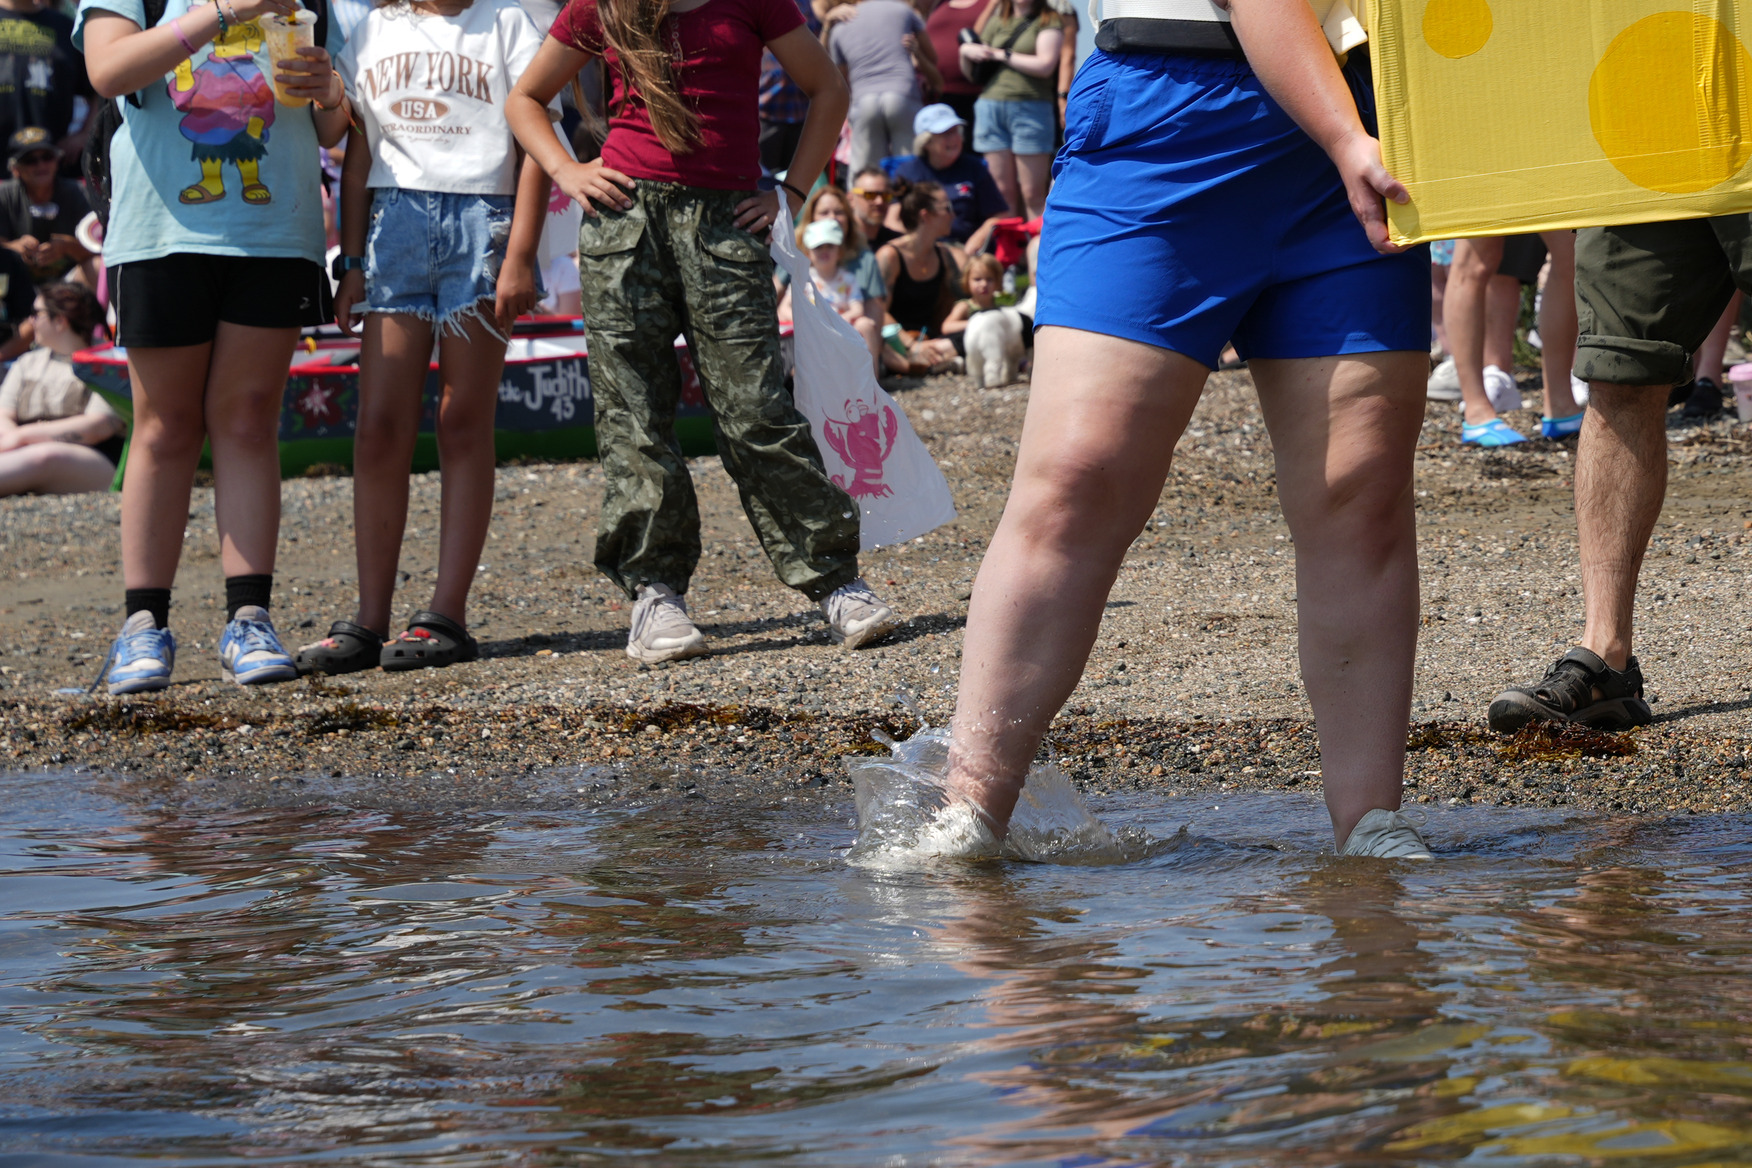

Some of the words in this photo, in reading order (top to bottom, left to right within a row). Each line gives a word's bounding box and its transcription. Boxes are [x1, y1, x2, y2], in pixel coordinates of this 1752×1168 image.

[364, 51, 421, 101] NEW
[426, 51, 494, 105] YORK
[401, 101, 438, 119] USA
[524, 359, 590, 411] Judith
[550, 395, 576, 422] 43
